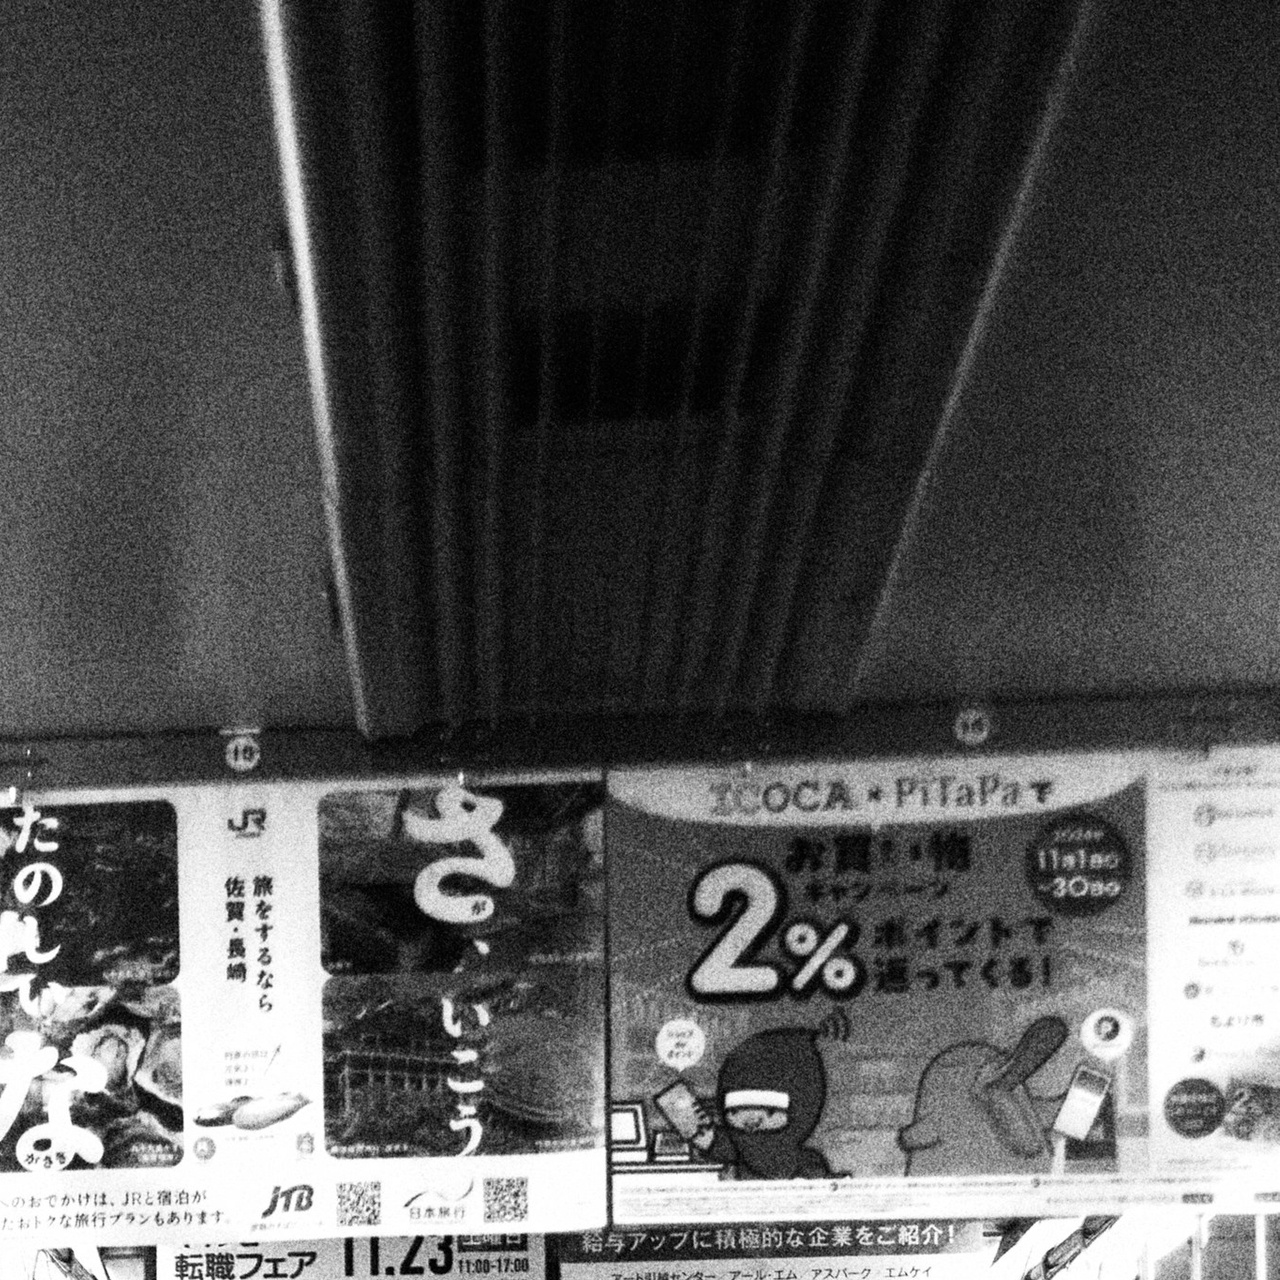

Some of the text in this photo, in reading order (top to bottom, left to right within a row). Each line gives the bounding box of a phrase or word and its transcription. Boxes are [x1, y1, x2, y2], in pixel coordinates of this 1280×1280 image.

[226, 806, 267, 832] JR
[224, 875, 247, 983] 佐賀・長崎
[253, 874, 273, 1012] 旅をするなら
[690, 860, 862, 998] 2%
[261, 1183, 315, 1219] JTB
[409, 1205, 466, 1220] 日本旅行
[458, 1257, 530, 1274] 11:00-17:00
[810, 1267, 872, 1280] アスパーク
[884, 1266, 932, 1278] エムケイ
